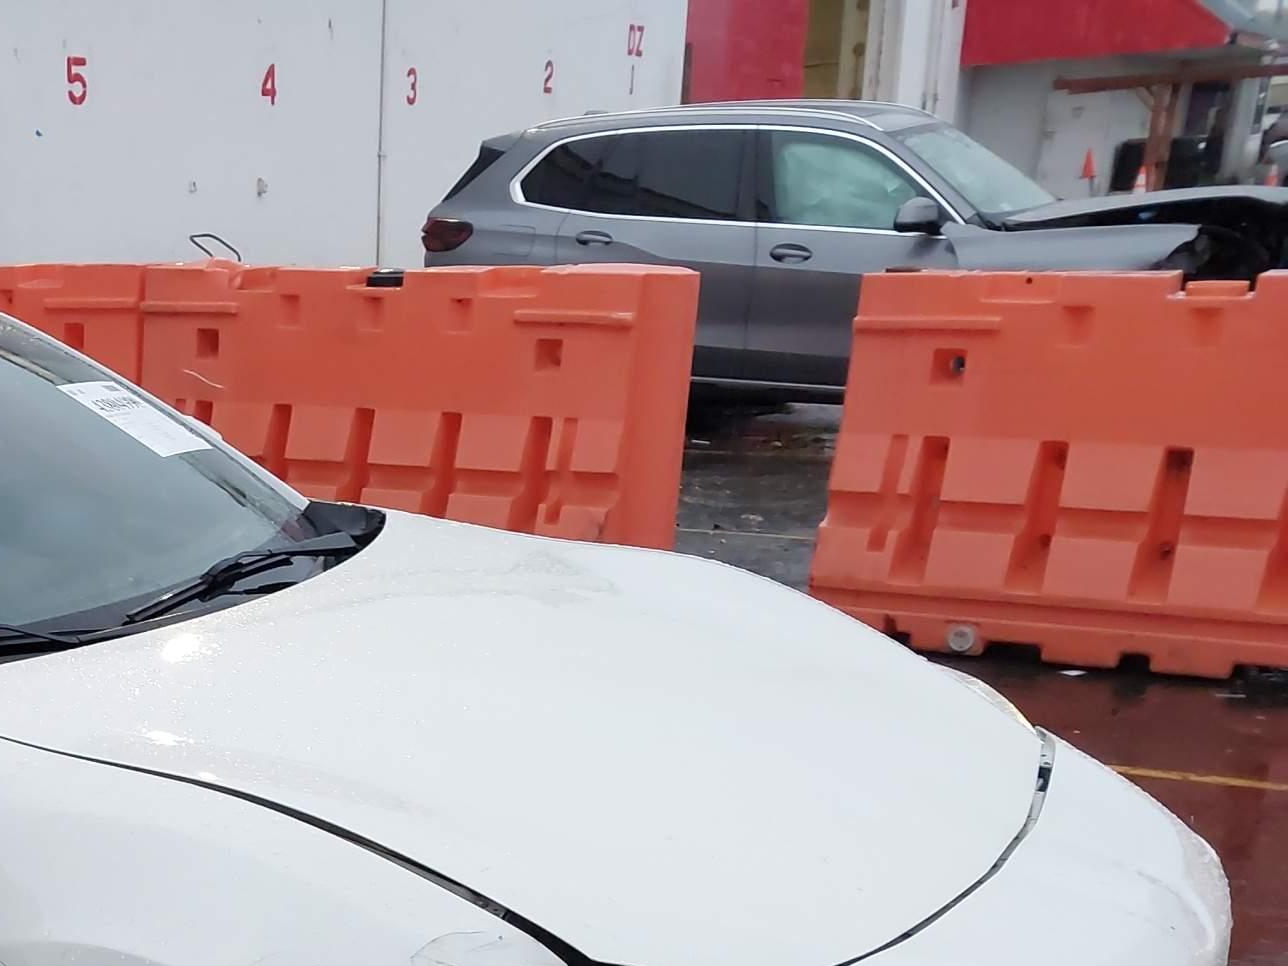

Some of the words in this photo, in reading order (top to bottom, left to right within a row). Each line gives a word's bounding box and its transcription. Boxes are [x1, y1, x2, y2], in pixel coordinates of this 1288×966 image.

[627, 23, 645, 57] DZ
[66, 56, 88, 106] 5
[260, 63, 278, 106] 4
[406, 67, 418, 106] 3
[542, 60, 554, 95] 2
